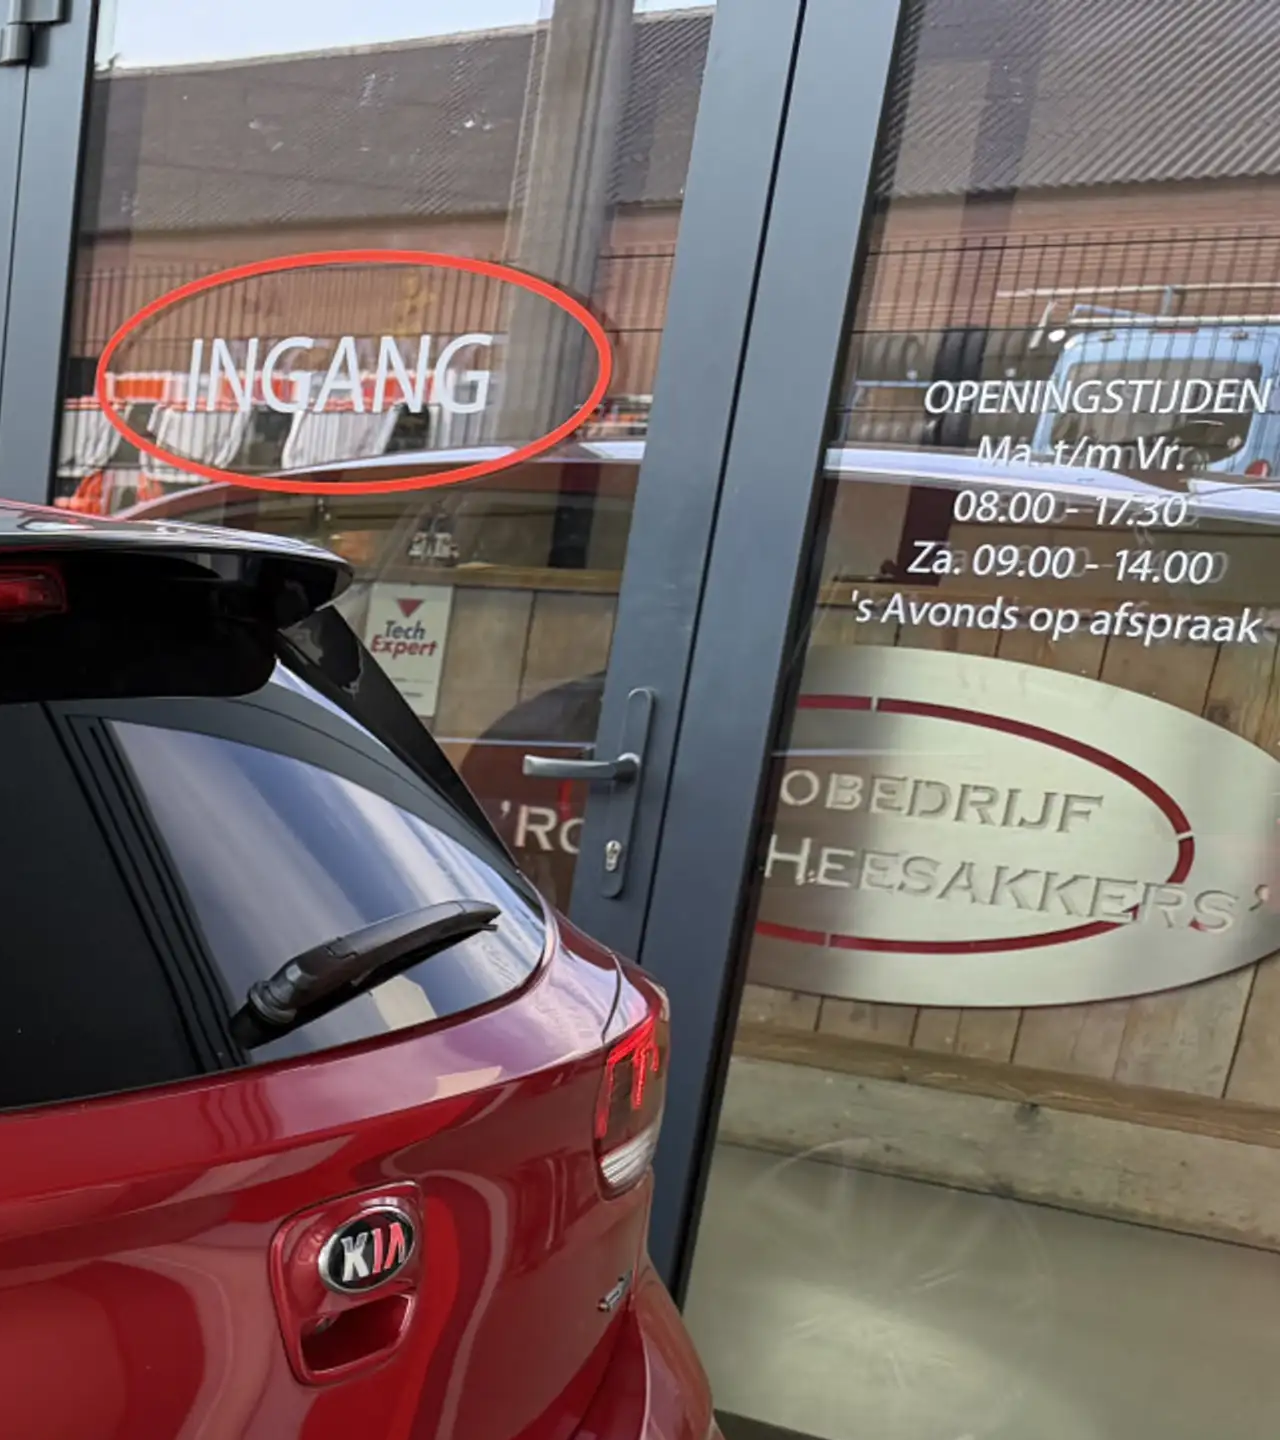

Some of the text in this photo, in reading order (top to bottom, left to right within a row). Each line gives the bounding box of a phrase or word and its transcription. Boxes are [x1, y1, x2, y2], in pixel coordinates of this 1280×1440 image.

[186, 333, 494, 414] INGANG
[923, 378, 1273, 414] OPENINGSTIJDEN
[1052, 436, 1122, 470] t/m
[1136, 436, 1186, 471] Vr.
[954, 490, 1057, 524] 08.00
[1095, 494, 1190, 526] 17.30
[907, 541, 962, 573] Za.
[973, 543, 1074, 579] 09.00
[1115, 549, 1215, 584] 14.00
[385, 619, 427, 641] Tech
[850, 590, 1263, 646] 's Avonds op afspraak
[370, 634, 437, 660] Expert
[340, 1221, 406, 1283] KIA
